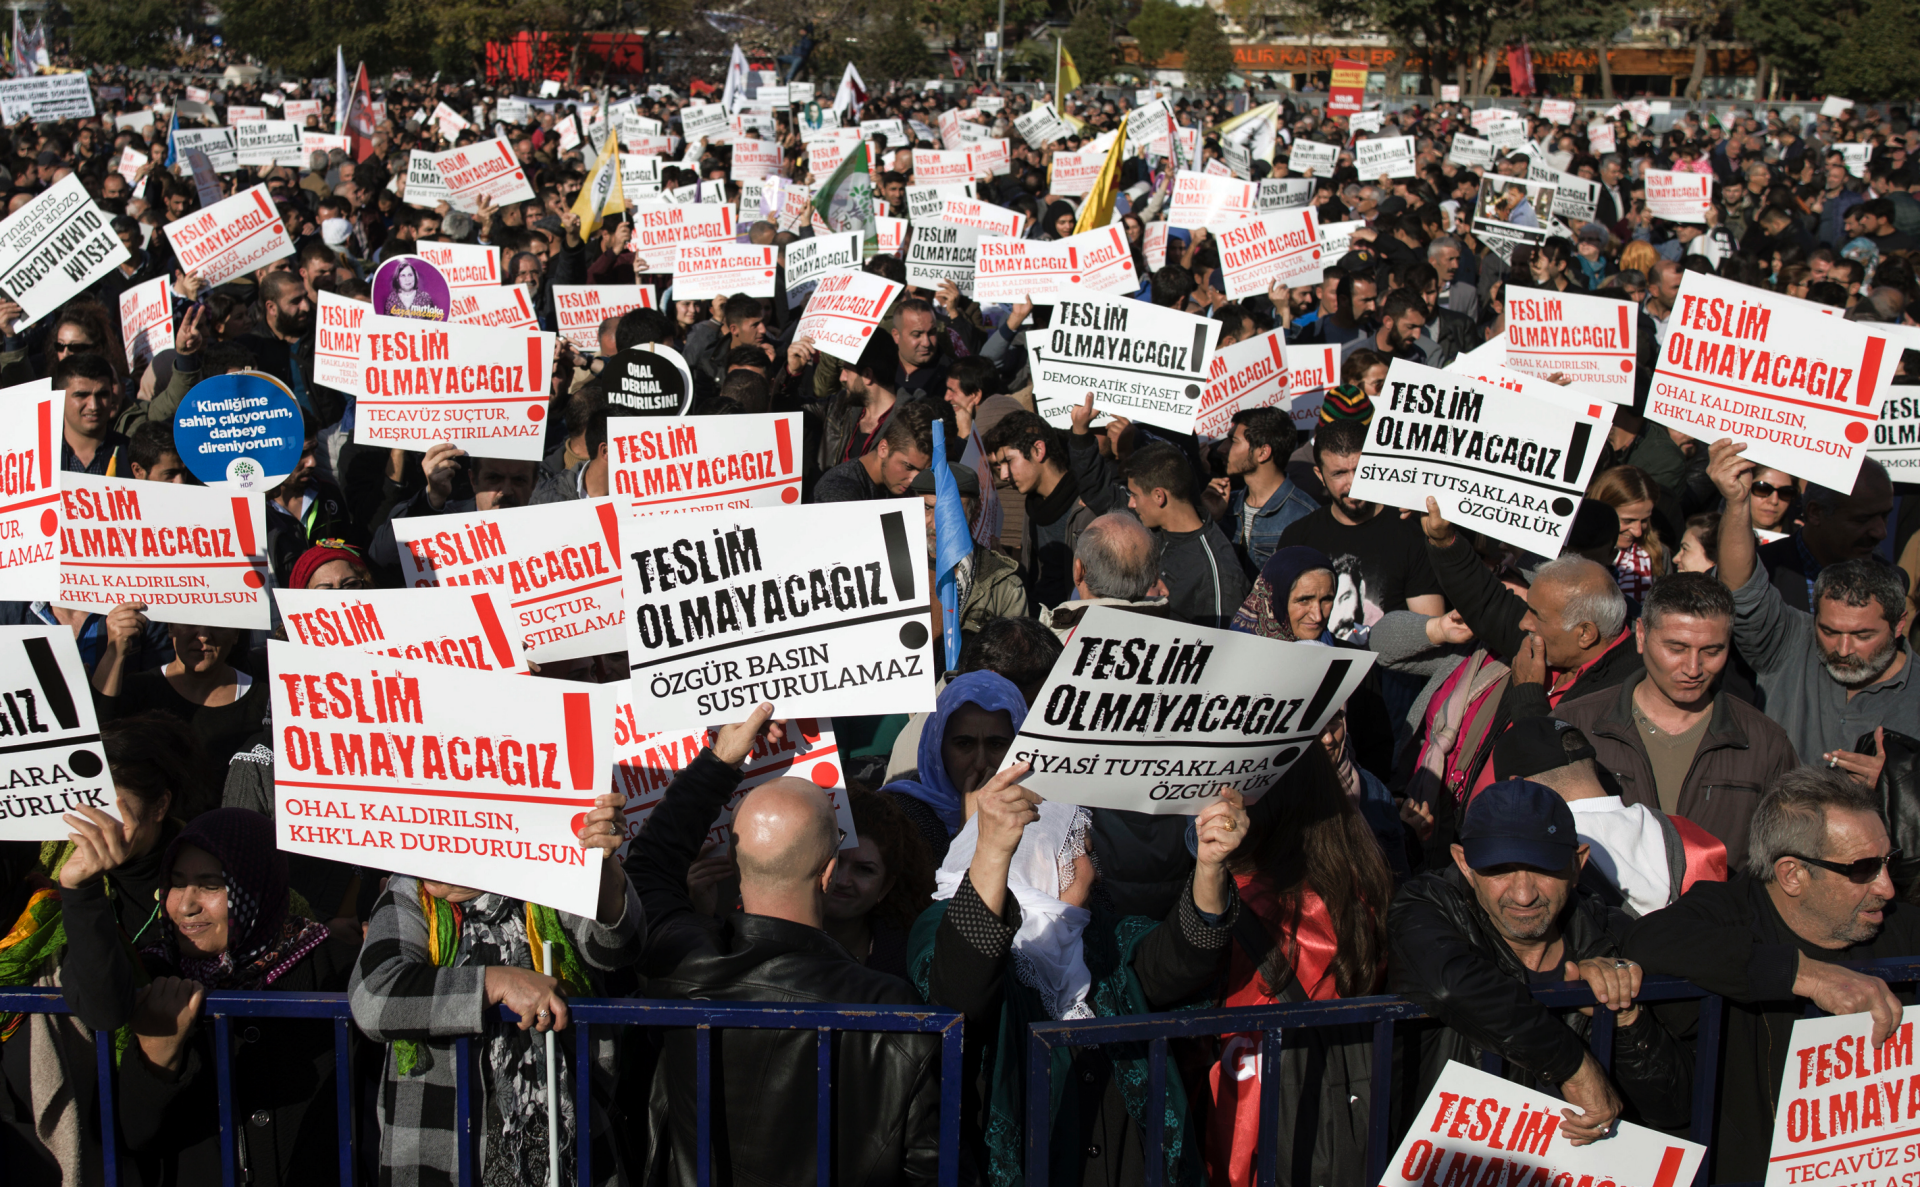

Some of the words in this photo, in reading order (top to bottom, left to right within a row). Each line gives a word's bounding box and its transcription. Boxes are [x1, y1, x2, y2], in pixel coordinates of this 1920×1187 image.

[240, 125, 267, 135] TESLİM
[413, 158, 436, 170] TESL
[437, 152, 470, 174] TESLİM
[812, 147, 840, 159] TESLİM
[915, 155, 941, 165] TESLİM
[1532, 167, 1559, 183] TESLİM
[1648, 176, 1672, 186] TESLİM
[746, 186, 762, 196] TESL
[910, 189, 938, 203] TESLİM
[1262, 183, 1287, 195] TESLİM
[643, 208, 683, 228] TESLİM
[947, 201, 981, 216] TESLİM
[172, 213, 217, 248] TESLİM
[918, 227, 957, 243] TESLİM
[1221, 221, 1266, 248] TESLİM
[62, 231, 117, 283] TESLİM
[680, 247, 722, 258] TESLİM
[788, 243, 817, 266] TESLİM
[982, 243, 1025, 255] TESLİM
[196, 249, 239, 280] AİKLİĞİ
[913, 268, 975, 280] BAŞKANLIĞ
[1232, 266, 1272, 285] TECAVÜZ
[817, 276, 853, 293] TESLİM
[121, 293, 138, 320] TESLİM
[411, 305, 443, 315] mutlaka
[558, 290, 601, 309] TESLİM
[1509, 298, 1562, 322] TESLİM
[1060, 302, 1128, 331] TESLİM
[1681, 294, 1771, 342] TESLİM
[368, 328, 449, 361] TESLİM
[627, 362, 653, 378] OHAL
[1510, 357, 1533, 370] OHAL
[1535, 359, 1600, 371] KALDIRILSIN,
[622, 376, 662, 393] DERHAL
[1042, 371, 1128, 392] DEMOKRATİK
[1131, 382, 1180, 400] SİYASET
[197, 396, 268, 412] Kimliğime
[608, 392, 677, 410] KALDIRILSIN!
[1096, 392, 1193, 415] ENGELLENEMEZ
[1390, 382, 1484, 423] TESLİM
[1656, 383, 1699, 405] OHAL
[1702, 391, 1807, 431] KALDIRILSIN,
[180, 415, 216, 428] sahip
[219, 408, 292, 426] çıkıyorum,
[368, 408, 440, 421] TECAVÜZ
[444, 408, 510, 423] SUÇTUR,
[210, 424, 266, 440] darbeye
[369, 424, 539, 441] MEŞRULAŞTIRILAMAZ
[1653, 400, 1715, 430] KHK'LAR
[1719, 418, 1853, 460] DURDURULSUN
[198, 436, 282, 454] direniyorum
[614, 423, 697, 464] TESLİM
[1360, 464, 1417, 483] SİYASİ
[1422, 472, 1549, 514] TUTSAKLARA
[61, 485, 141, 521] ESLİM
[1458, 498, 1562, 537] ÖZGÜRLÜK
[405, 519, 506, 572] TESLİM
[631, 524, 762, 594] TESLİM
[103, 576, 210, 588] KALDIRILSIN,
[131, 592, 258, 605] DURDURULSUN
[289, 599, 385, 647] TESLİM
[519, 597, 601, 627] SUÇTUR,
[524, 611, 626, 649] ŞTIRILAMA
[650, 660, 742, 698] ÖZGÜR
[747, 644, 829, 675] BASIN
[1072, 637, 1213, 685] TESLİM
[279, 669, 423, 724] TESLİM
[698, 655, 923, 716] SUSTURULAMAZ
[1012, 749, 1099, 774] SİYASİ
[1105, 758, 1268, 778] TUTSAKLARA
[286, 799, 355, 819] OHAL
[361, 804, 519, 833] KALDIRILSIN,
[290, 825, 395, 849] KHK'LAR
[400, 832, 587, 866] DURDURULSUN
[1430, 1092, 1560, 1157] TESLİM
[1786, 1147, 1898, 1184] TECAVÜZ
